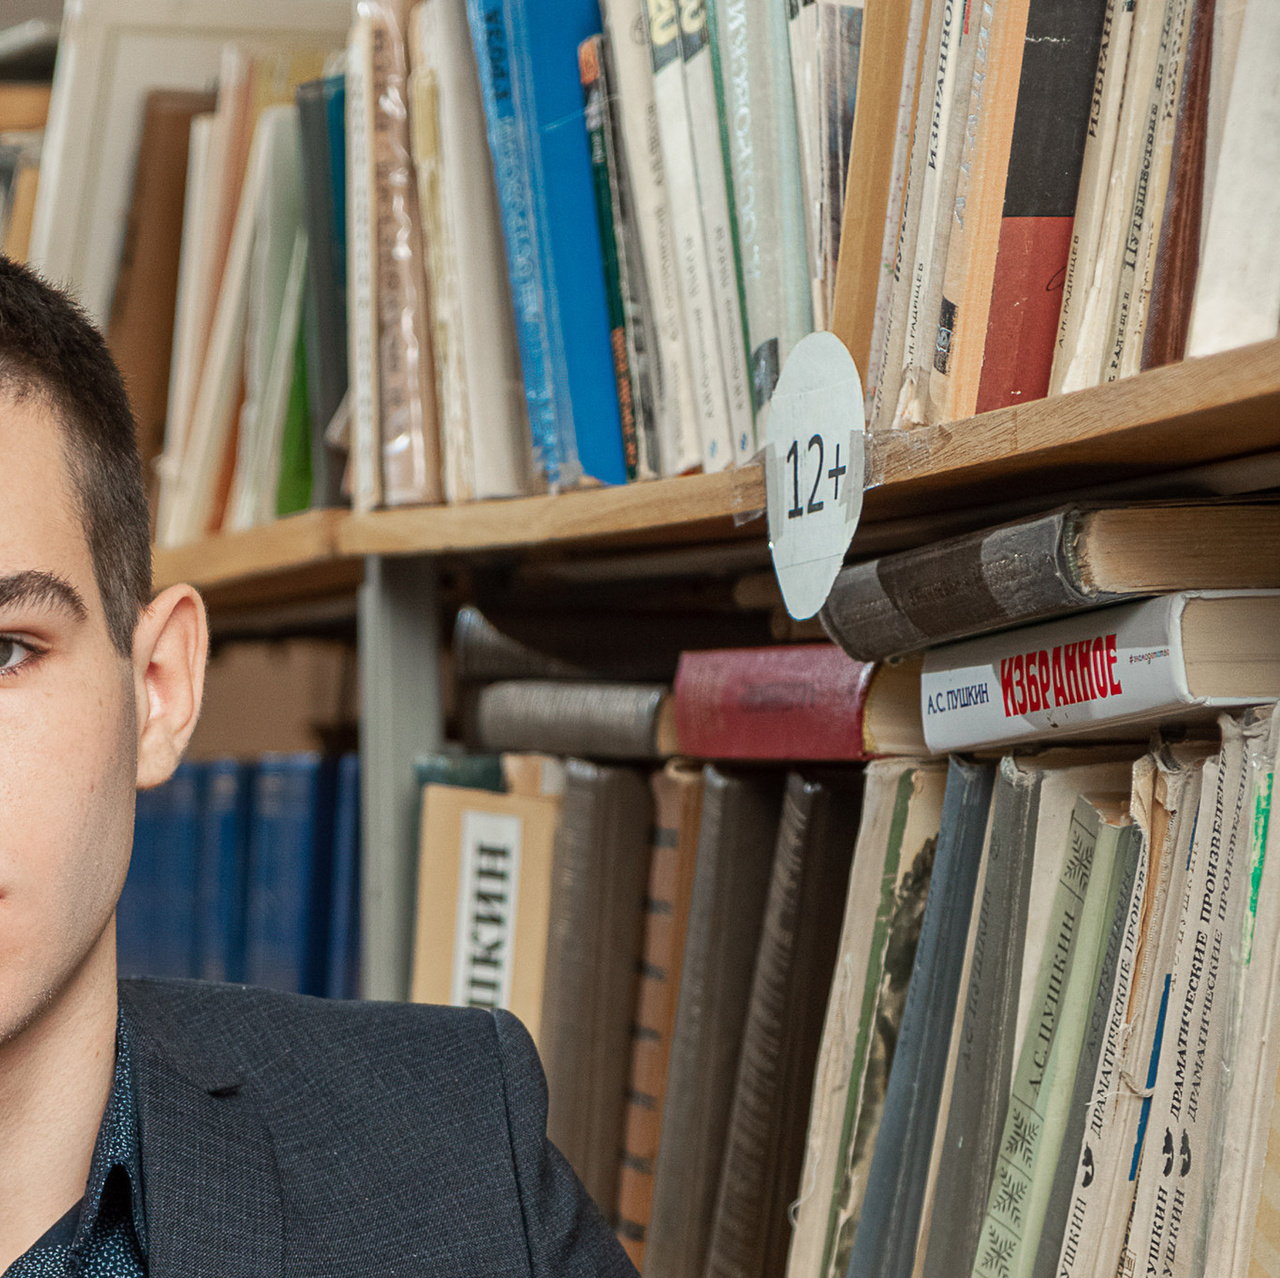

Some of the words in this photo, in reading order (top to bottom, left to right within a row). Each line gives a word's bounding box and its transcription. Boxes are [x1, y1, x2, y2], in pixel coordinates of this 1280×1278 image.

[1063, 234, 1081, 311] РАДИЩЕВ
[786, 433, 847, 520] 12+
[947, 682, 991, 710] ПУШКИН
[1000, 632, 1123, 718] ИЗБРАННОЕ
[1038, 909, 1075, 1047] ПУШКИН
[1170, 930, 1209, 1123] ДРАМАТИЧЕСКИЕ
[1186, 926, 1224, 1123] ДРАМАТИЧЕСКИЕ
[1090, 959, 1132, 1140] ДРАМАТИЧЕСКИЕ
